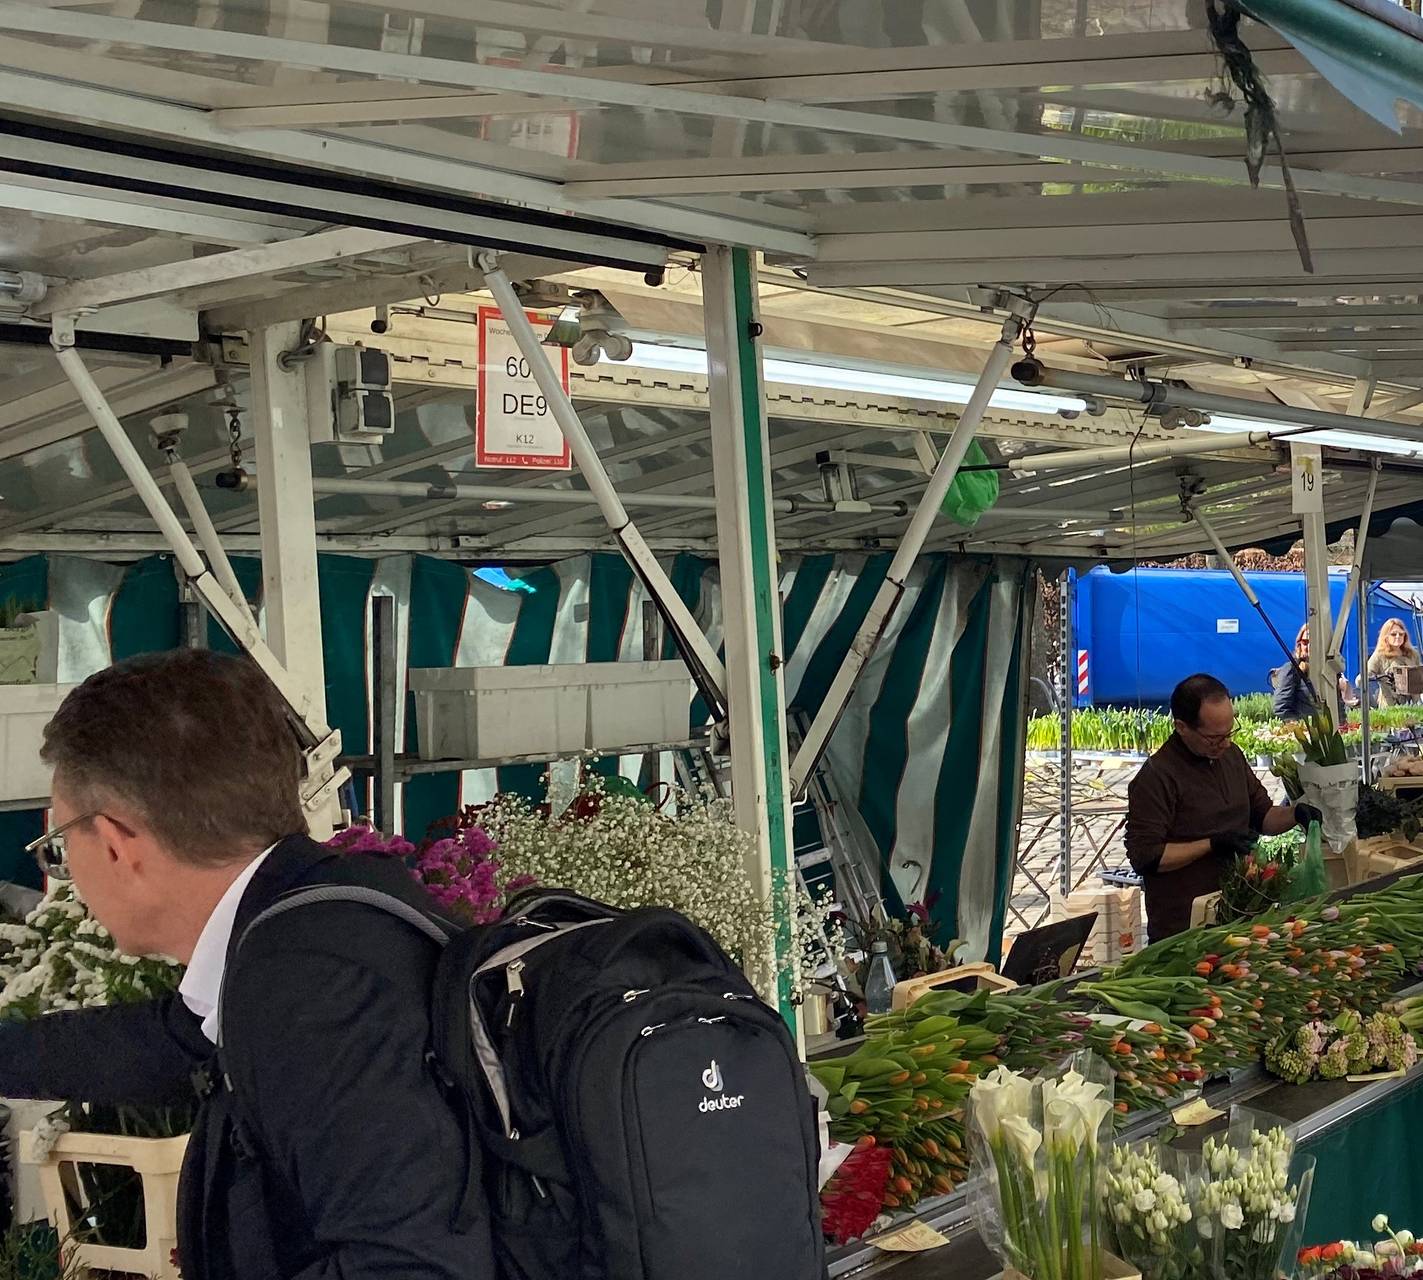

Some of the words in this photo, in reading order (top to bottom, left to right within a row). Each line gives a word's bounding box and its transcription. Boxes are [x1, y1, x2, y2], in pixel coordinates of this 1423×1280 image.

[503, 393, 547, 416] DE9
[516, 434, 535, 444] K12
[1301, 471, 1314, 491] 19
[698, 1093, 745, 1112] deuter
